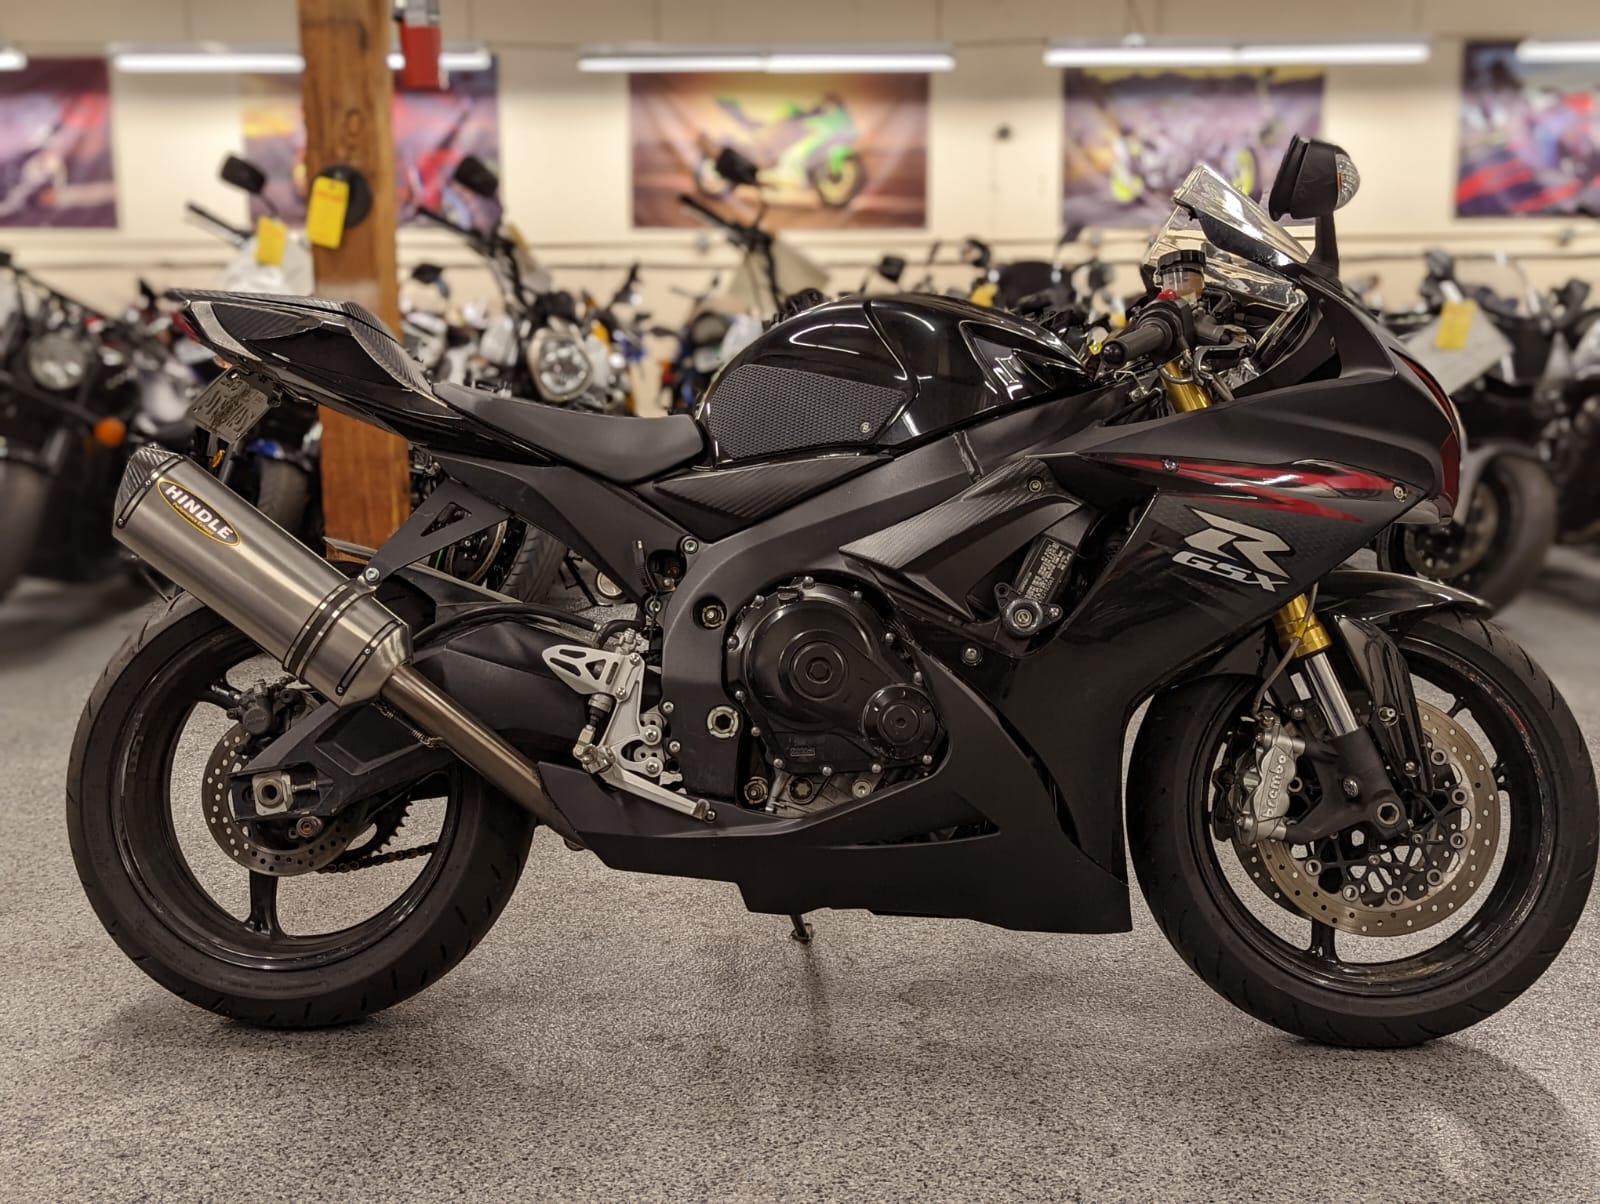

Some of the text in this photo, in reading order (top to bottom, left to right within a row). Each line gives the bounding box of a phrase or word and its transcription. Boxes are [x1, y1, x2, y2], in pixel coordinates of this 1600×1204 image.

[165, 485, 233, 539] HINDLE
[1172, 551, 1288, 592] GSX
[1260, 755, 1287, 818] brembo
